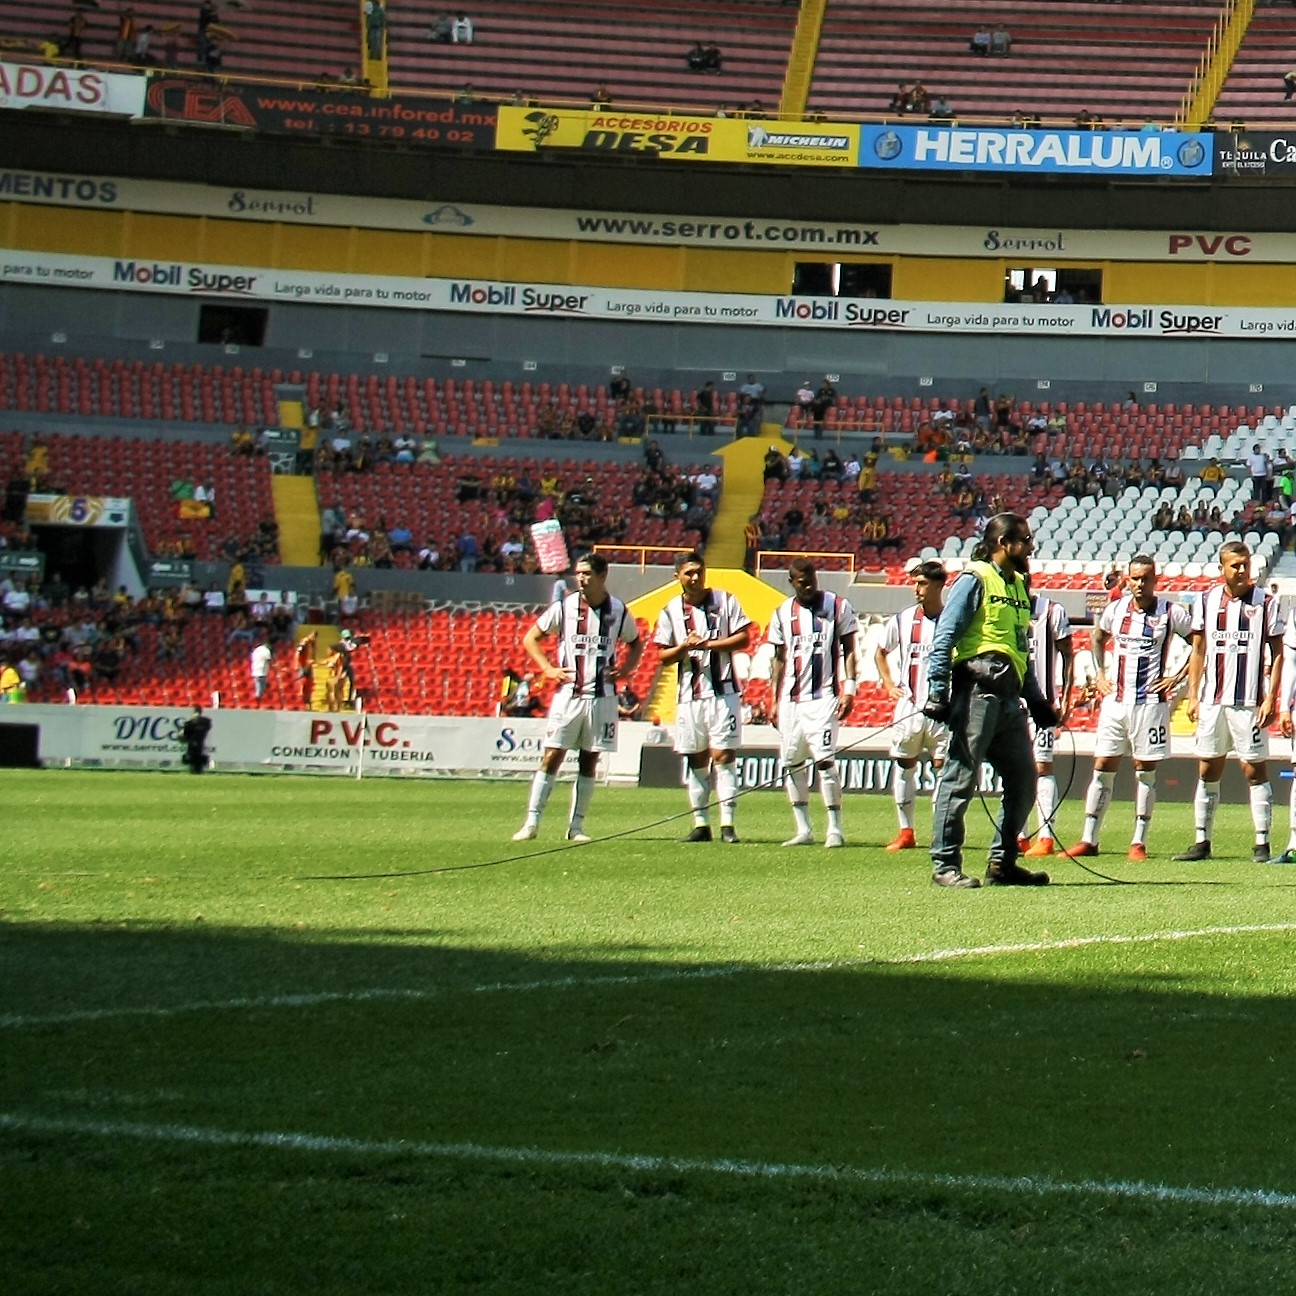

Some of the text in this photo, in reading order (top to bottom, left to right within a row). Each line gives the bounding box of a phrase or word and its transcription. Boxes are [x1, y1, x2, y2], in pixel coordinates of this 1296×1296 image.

[592, 116, 713, 133] ACCESORIOS
[412, 127, 440, 140] 40
[449, 129, 474, 142] 02
[581, 130, 709, 155] DESA
[767, 134, 848, 148] MICHELIN
[1220, 151, 1267, 160] TEQUILA
[577, 215, 879, 246] www.serrot.com.mx
[1168, 234, 1252, 255] PVC
[4, 265, 95, 280] para motor
[114, 260, 257, 293] Mobil Super
[274, 281, 431, 302] Larga vida para motor
[451, 283, 588, 311] Mobil Super
[607, 301, 759, 318] Larga vida para motor
[776, 299, 910, 326] Mobil Super
[927, 313, 1075, 329] Larga vida para motor
[1092, 308, 1223, 332] Mobil Super
[1240, 320, 1274, 333] Larga
[114, 716, 188, 740] DICS
[728, 715, 737, 731] 3
[310, 719, 412, 748] P.V.C.
[1150, 726, 1167, 745] 32
[1252, 726, 1261, 742] 2
[272, 746, 435, 762] CONEXION TUBERIA
